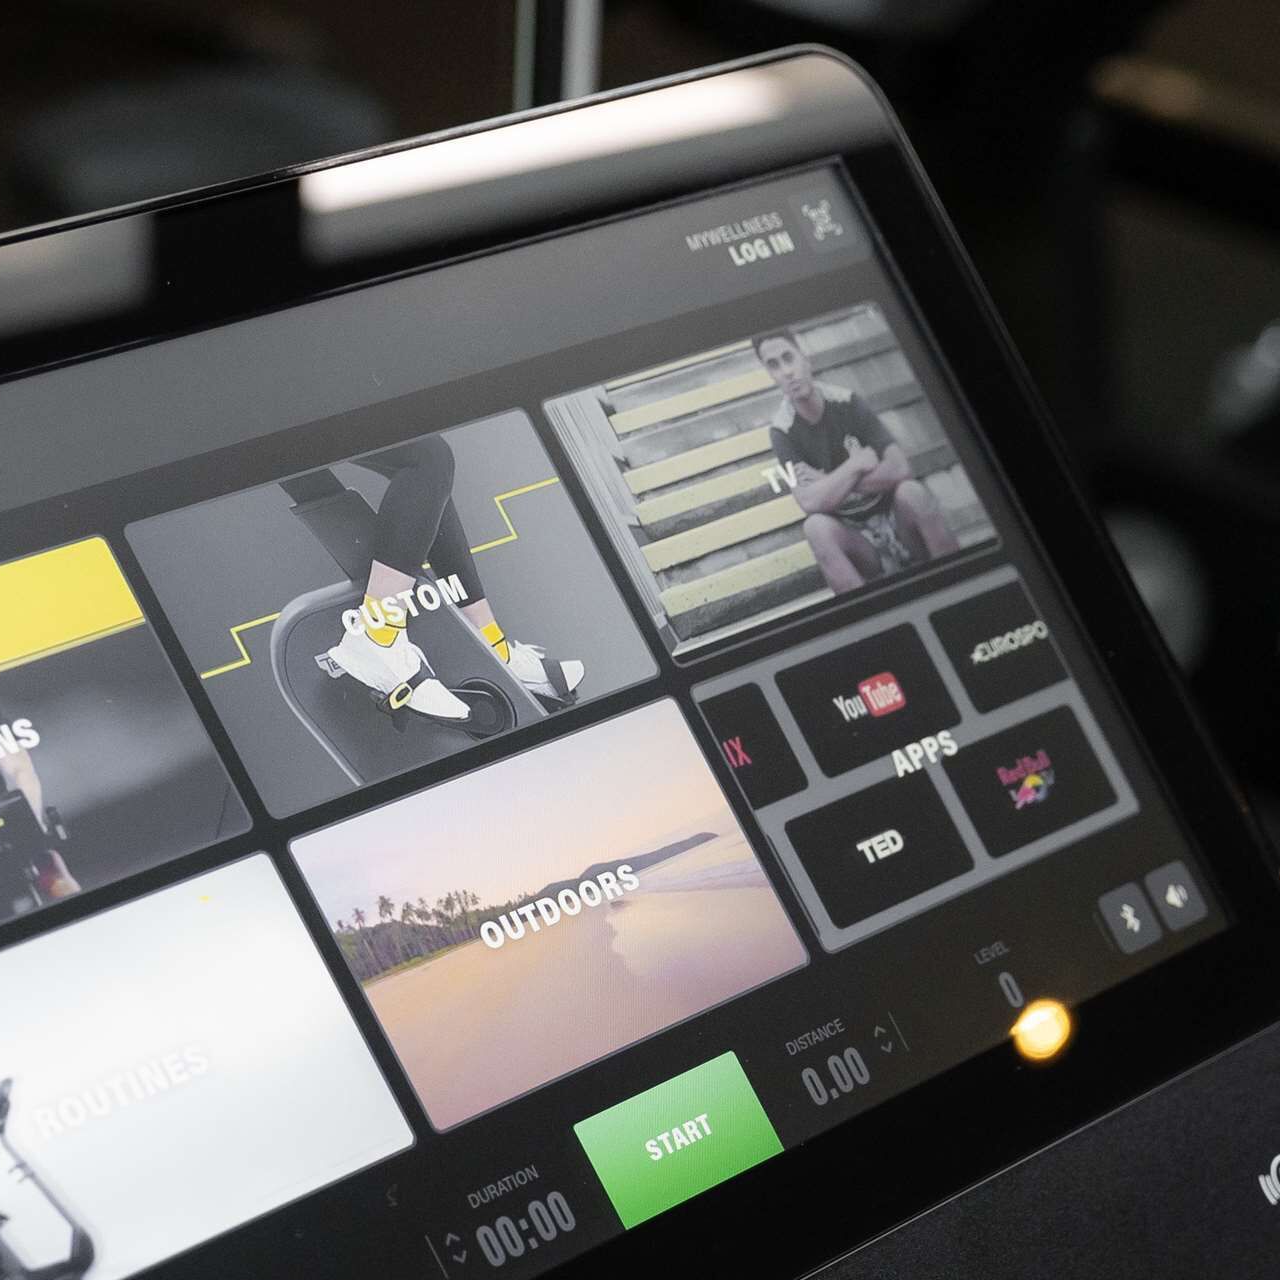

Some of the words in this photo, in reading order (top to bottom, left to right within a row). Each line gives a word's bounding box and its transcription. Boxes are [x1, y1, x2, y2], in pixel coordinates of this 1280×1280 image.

[685, 212, 783, 251] MYWELLNESS
[728, 238, 771, 266] LOG
[768, 230, 795, 254] IN
[761, 460, 797, 494] TV
[342, 574, 468, 636] CUSTOM
[891, 730, 958, 777] APPS
[856, 829, 904, 863] TED
[479, 864, 640, 949] OUTDOORS
[974, 941, 1009, 965] LEVEL
[999, 972, 1023, 1008] 0
[785, 1018, 844, 1056] DISTANCE
[33, 1046, 209, 1140] ROUTINES
[801, 1047, 870, 1106] 0.00
[644, 1114, 713, 1161] START
[467, 1165, 539, 1209] DURATION
[476, 1191, 576, 1267] 00:00
